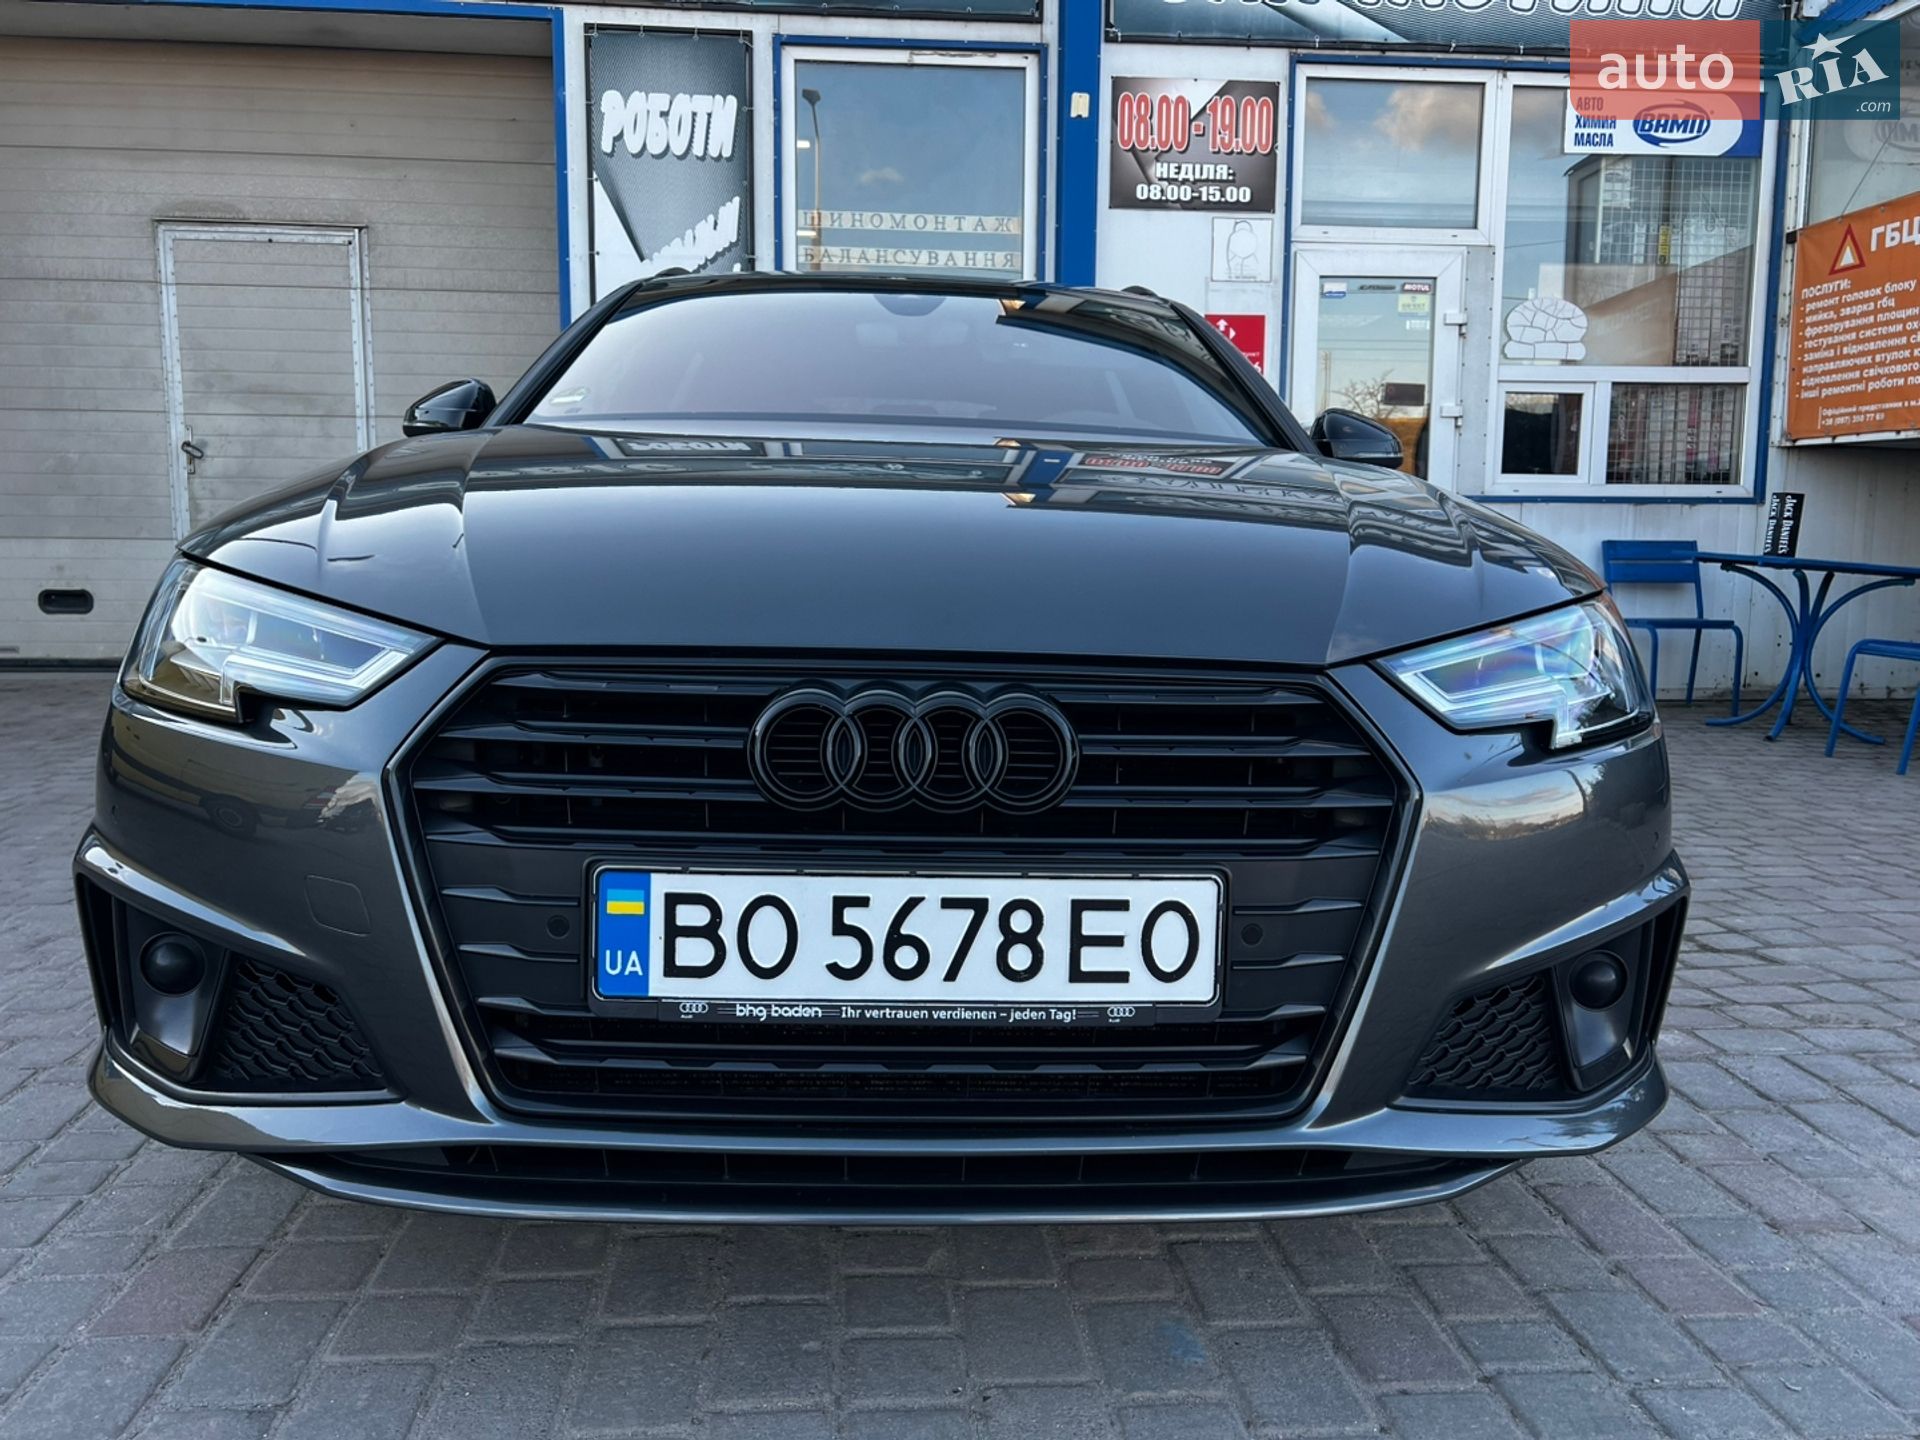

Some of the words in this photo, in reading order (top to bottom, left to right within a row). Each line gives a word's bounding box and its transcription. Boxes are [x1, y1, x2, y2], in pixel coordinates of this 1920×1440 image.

[1576, 96, 1605, 111] АВТО
[601, 90, 738, 158] РОБОТИ
[1118, 92, 1190, 152] 08.00
[1207, 95, 1274, 154] 19.00
[1575, 114, 1617, 130] ХИМИЯ
[1638, 113, 1707, 134] ВАМП
[1574, 132, 1614, 148] МАСЛА
[1155, 162, 1234, 180] НЕДІЛЯ:
[1136, 184, 1252, 202] 08.00-15.00
[803, 211, 1013, 233] ШИНОМОНТАЖ
[804, 248, 1016, 268] БАЛАНСУВАННЯ
[1842, 286, 1883, 303] головок
[1884, 279, 1918, 294] блоку
[1877, 296, 1896, 309] гбц
[1877, 306, 1920, 322] площин
[1859, 323, 1904, 339] системи
[1875, 349, 1911, 363] втулок
[1868, 377, 1905, 392] роботи
[662, 892, 799, 980] BO
[825, 894, 1044, 982] 5678
[1068, 898, 1200, 983] EO
[604, 949, 644, 976] UA
[735, 1003, 767, 1021] bhg
[771, 1004, 822, 1018] baden
[841, 1006, 864, 1020] Ihr
[864, 1008, 928, 1020] vertrauen
[932, 1006, 997, 1021] verdienen
[1008, 1007, 1046, 1023] jeden
[1048, 1008, 1076, 1023] Tag!
